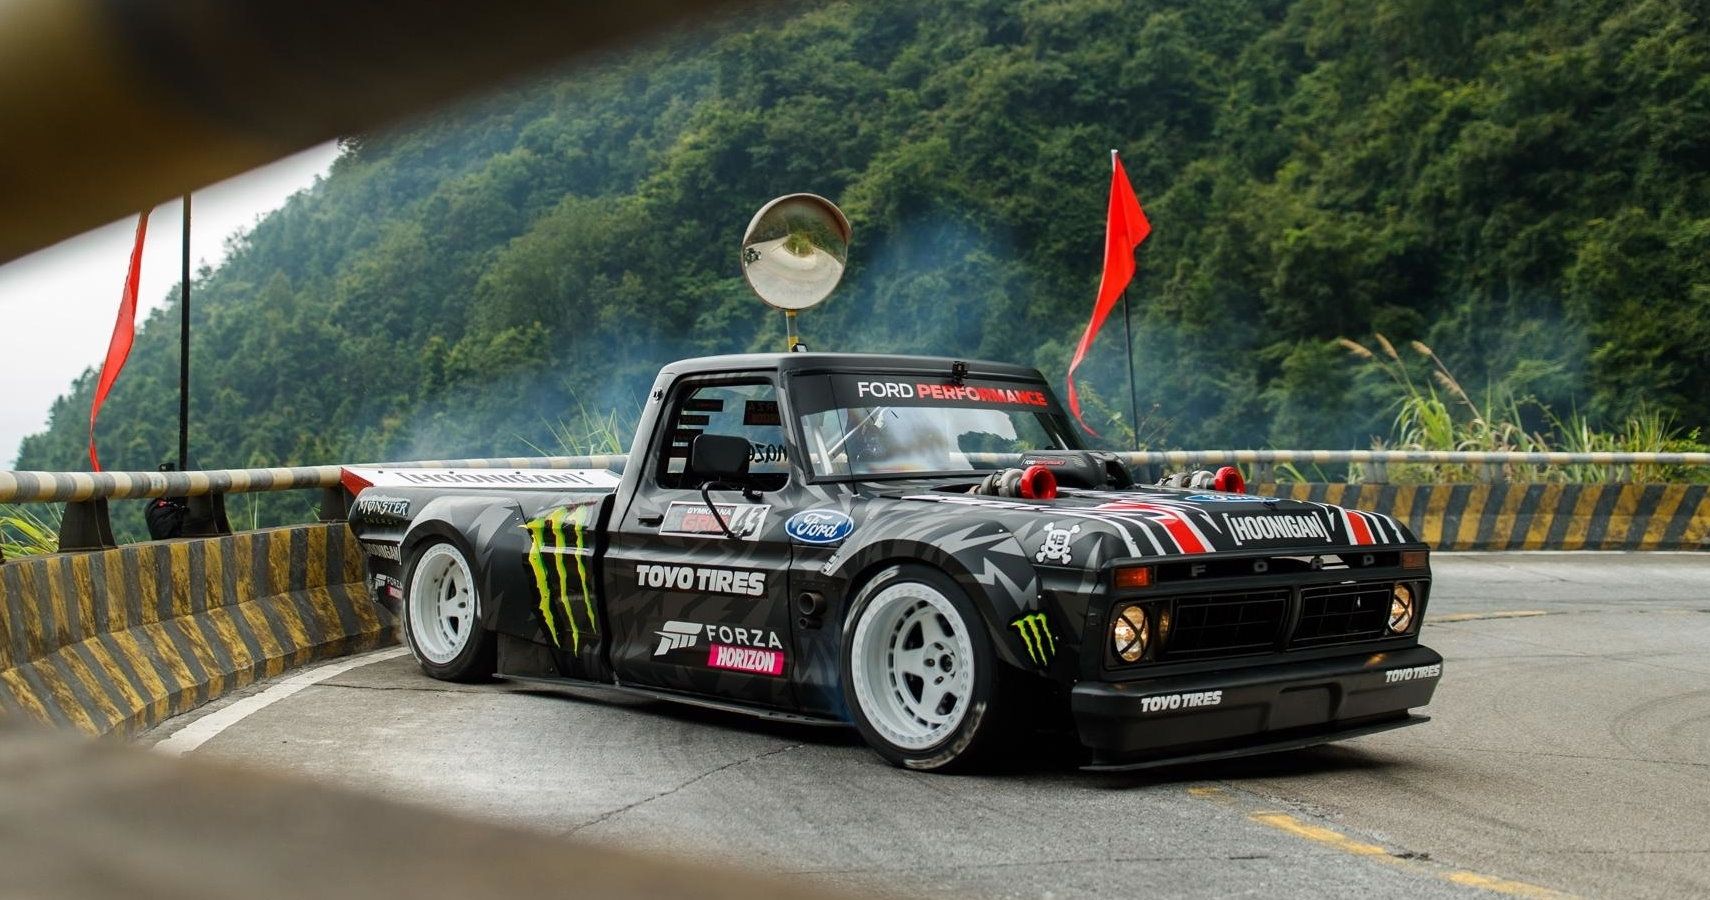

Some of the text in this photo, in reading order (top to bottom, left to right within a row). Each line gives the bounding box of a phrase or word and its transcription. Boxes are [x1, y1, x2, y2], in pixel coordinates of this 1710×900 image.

[858, 381, 1048, 407] FORD PERFORMANCE
[358, 496, 408, 516] MONSTER
[796, 513, 842, 538] Ford
[1050, 533, 1067, 545] 43
[1190, 554, 1375, 578] FORD
[636, 564, 766, 596] TOYO TIRES
[705, 624, 783, 649] FORZA
[716, 646, 776, 672] HORIZON
[1385, 664, 1440, 683] TOYO TIRES
[1141, 690, 1223, 712] TOYO TIRES
